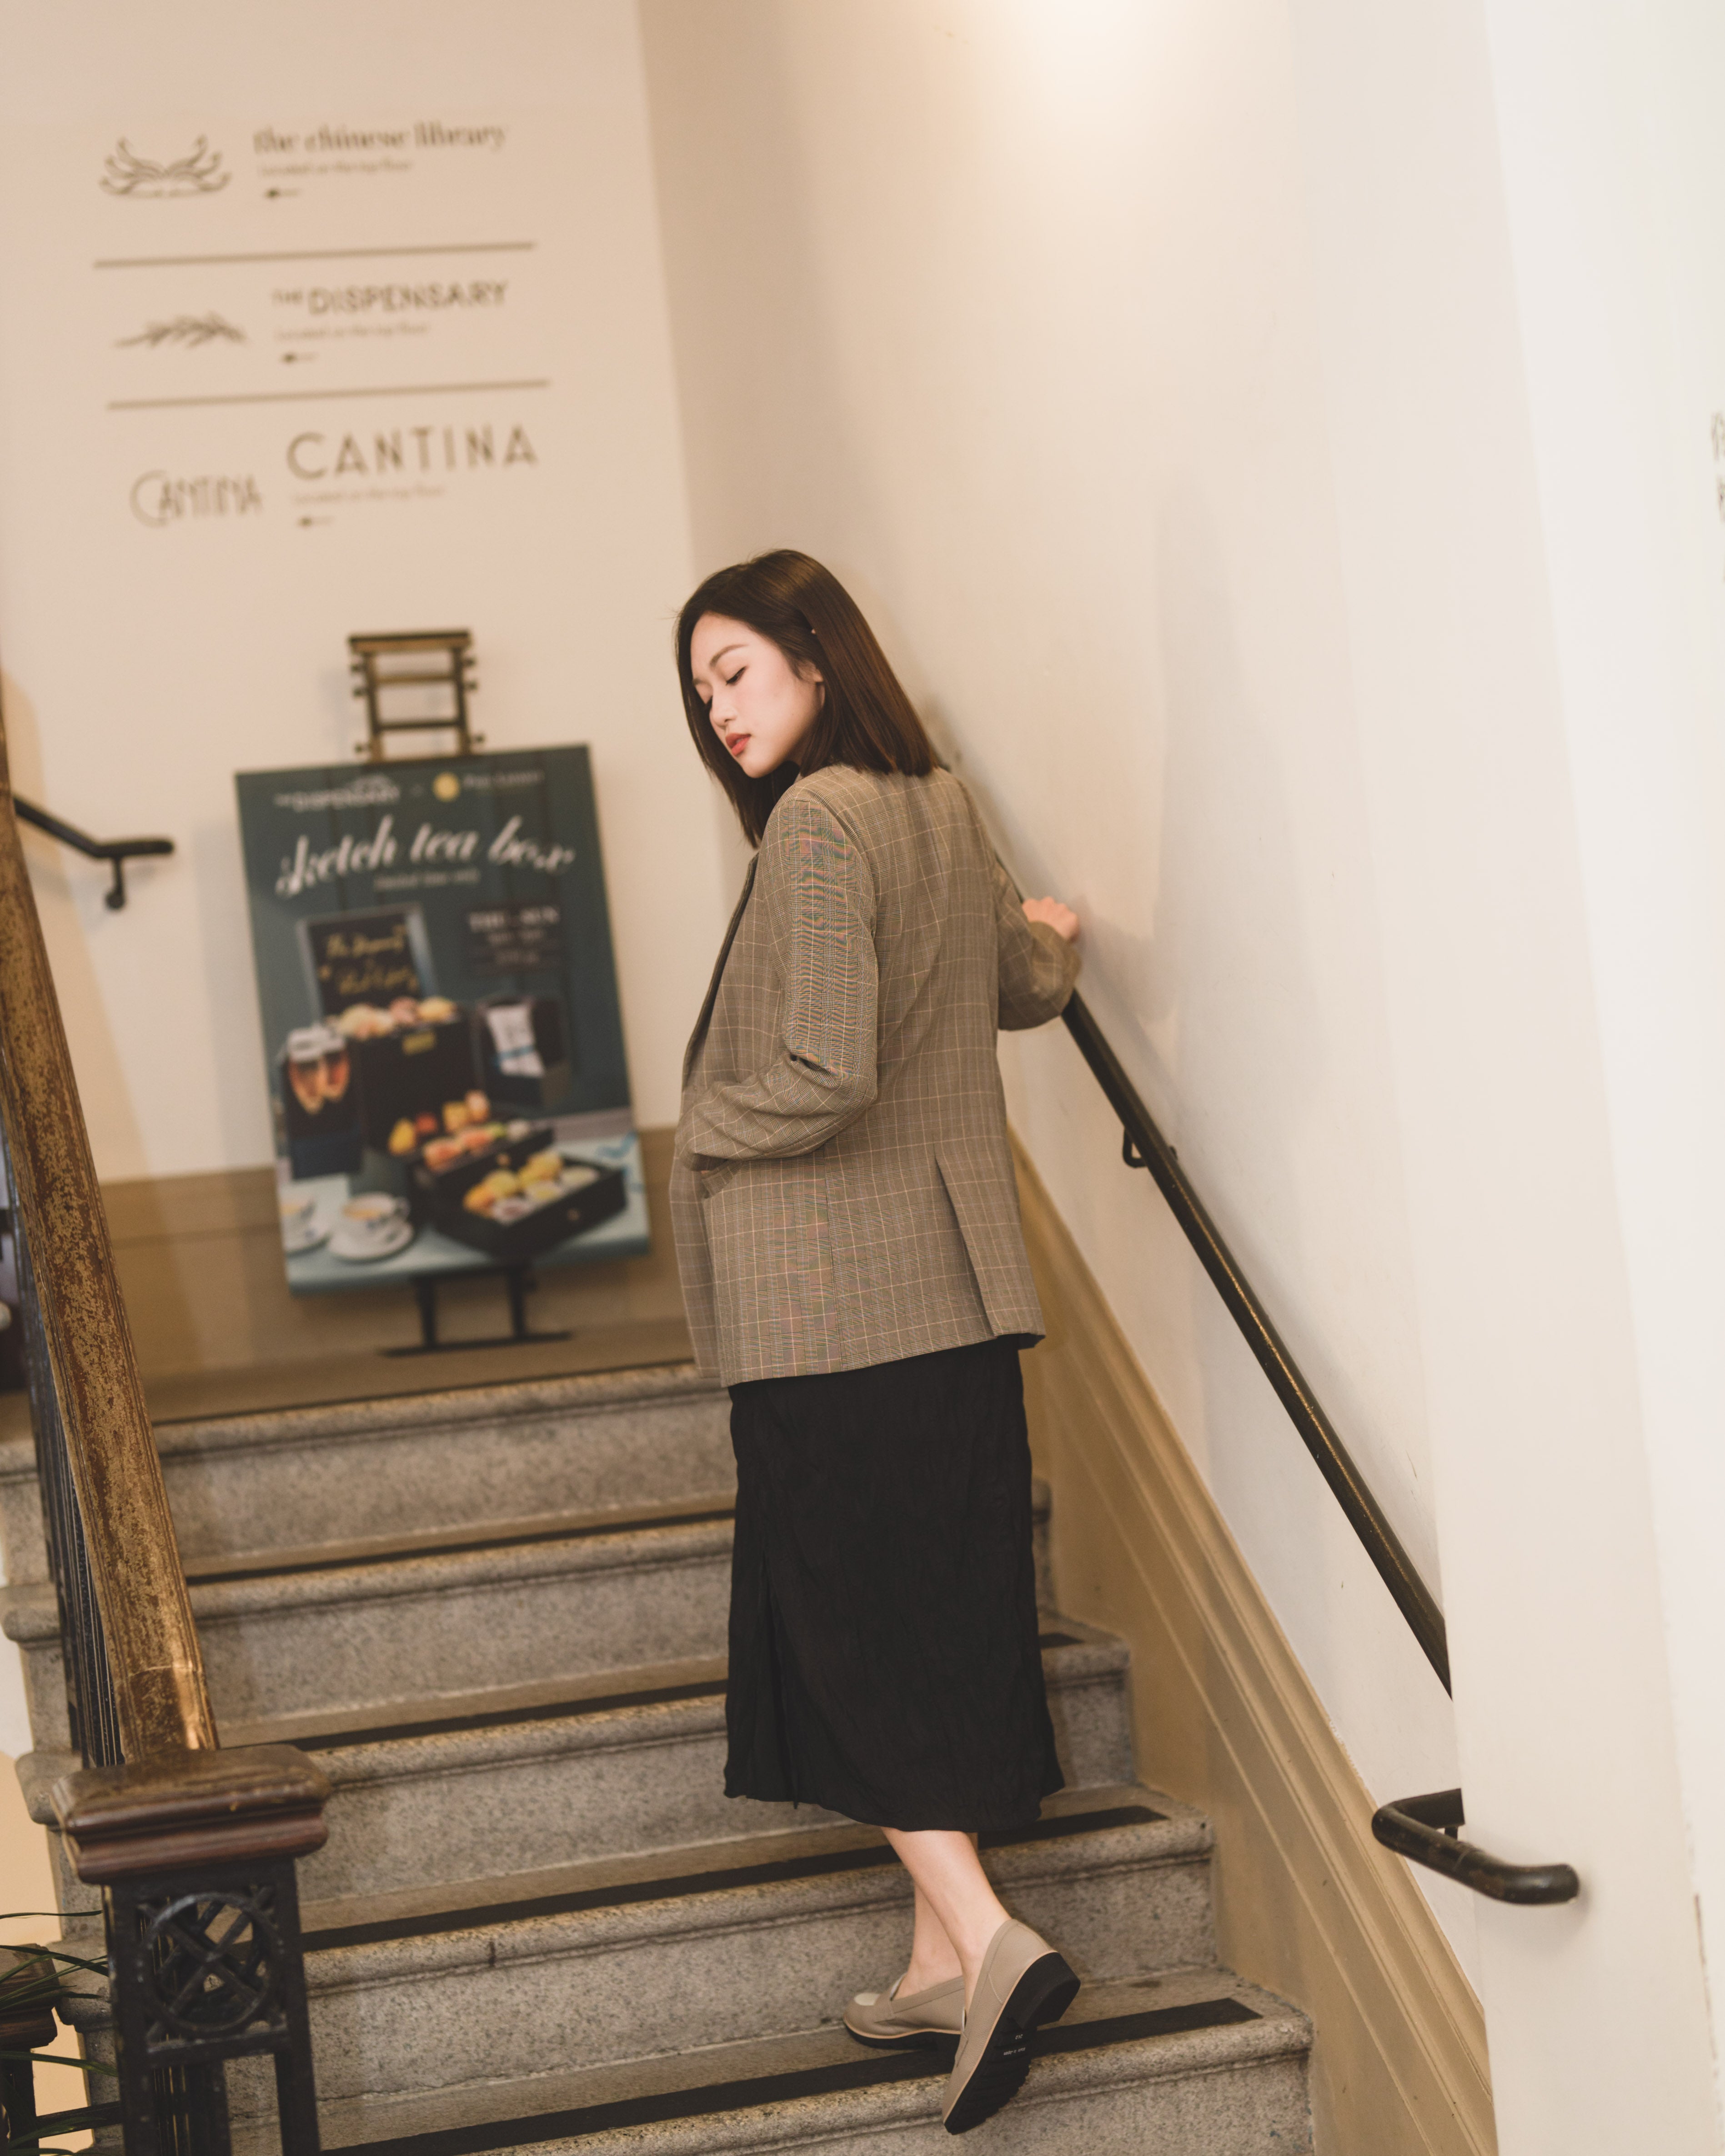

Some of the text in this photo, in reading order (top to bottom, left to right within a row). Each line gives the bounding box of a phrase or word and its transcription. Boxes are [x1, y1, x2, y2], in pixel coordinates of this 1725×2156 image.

[253, 120, 507, 155] the chinese library
[308, 280, 508, 315] DISPENSARY
[286, 423, 539, 480] CANTINA
[275, 814, 397, 898] sketch
[409, 822, 480, 863] tea
[488, 815, 576, 872] box
